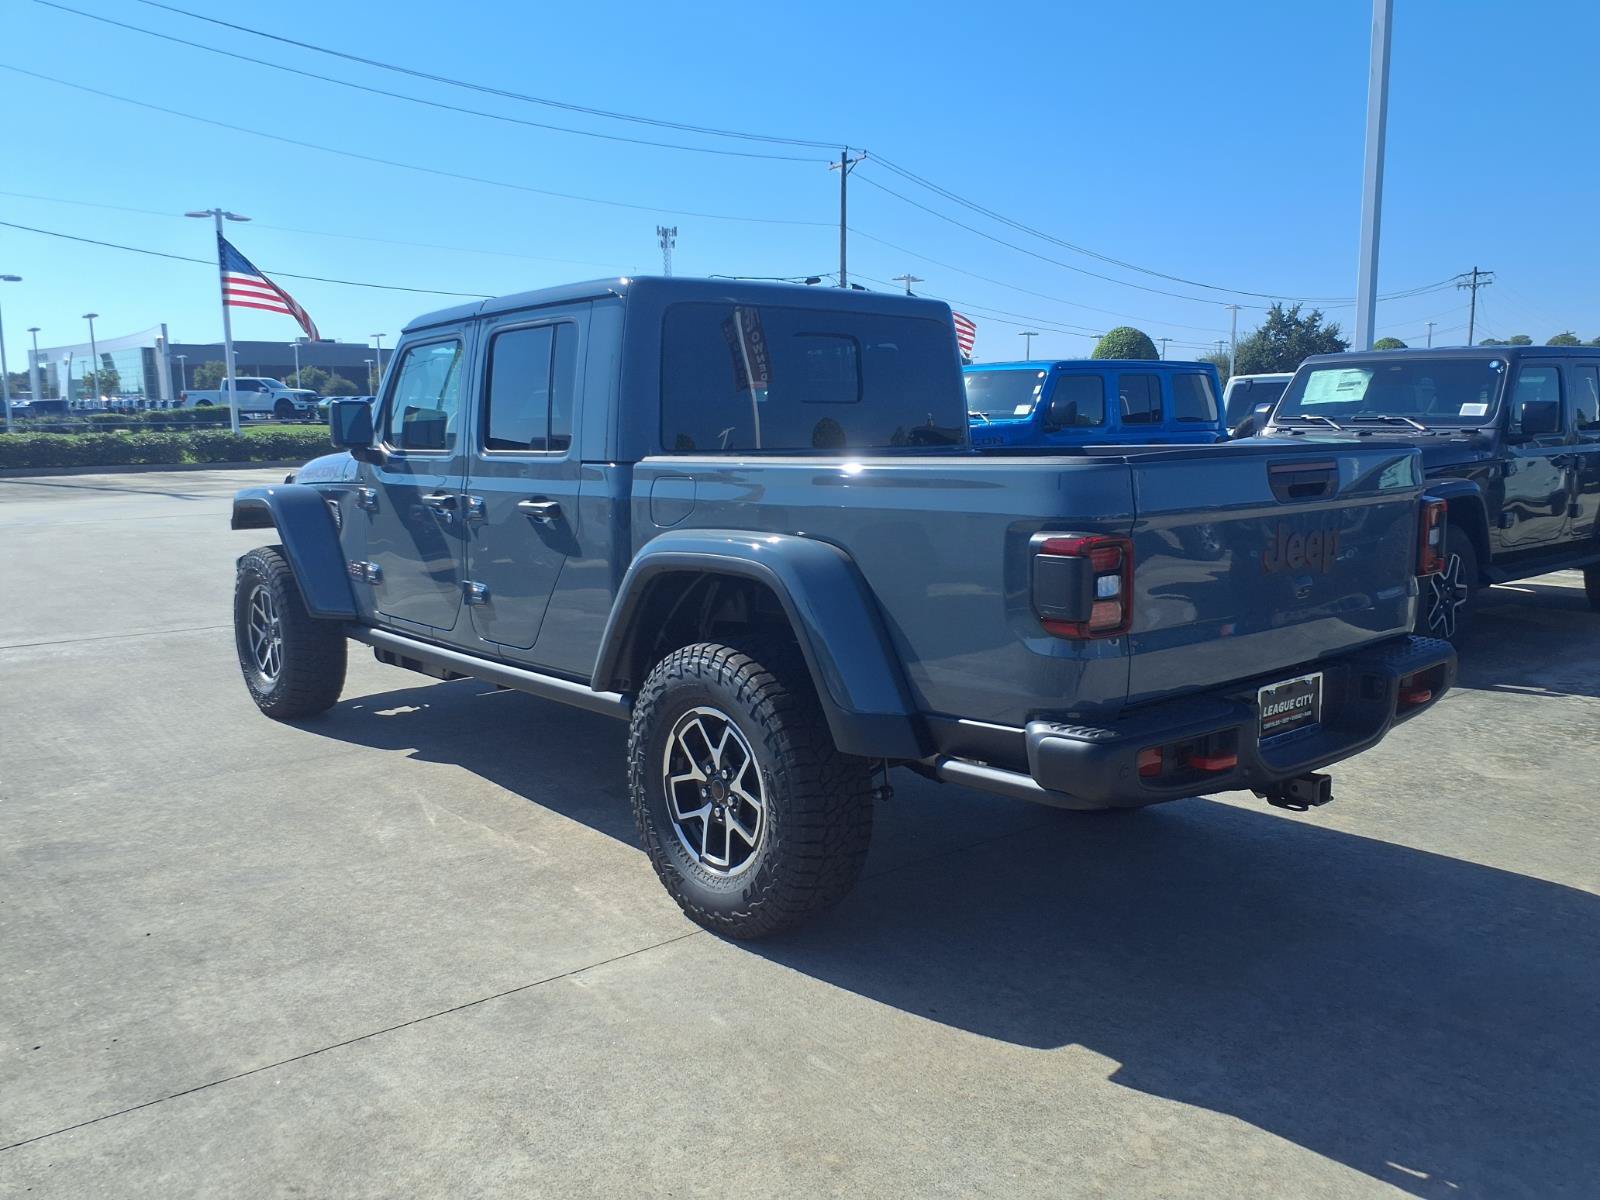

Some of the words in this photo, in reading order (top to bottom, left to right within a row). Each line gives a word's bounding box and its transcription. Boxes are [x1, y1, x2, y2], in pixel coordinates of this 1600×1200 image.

[1262, 522, 1340, 576] Jeep
[1263, 698, 1295, 717] LEAGUE
[1295, 693, 1314, 707] CITY
